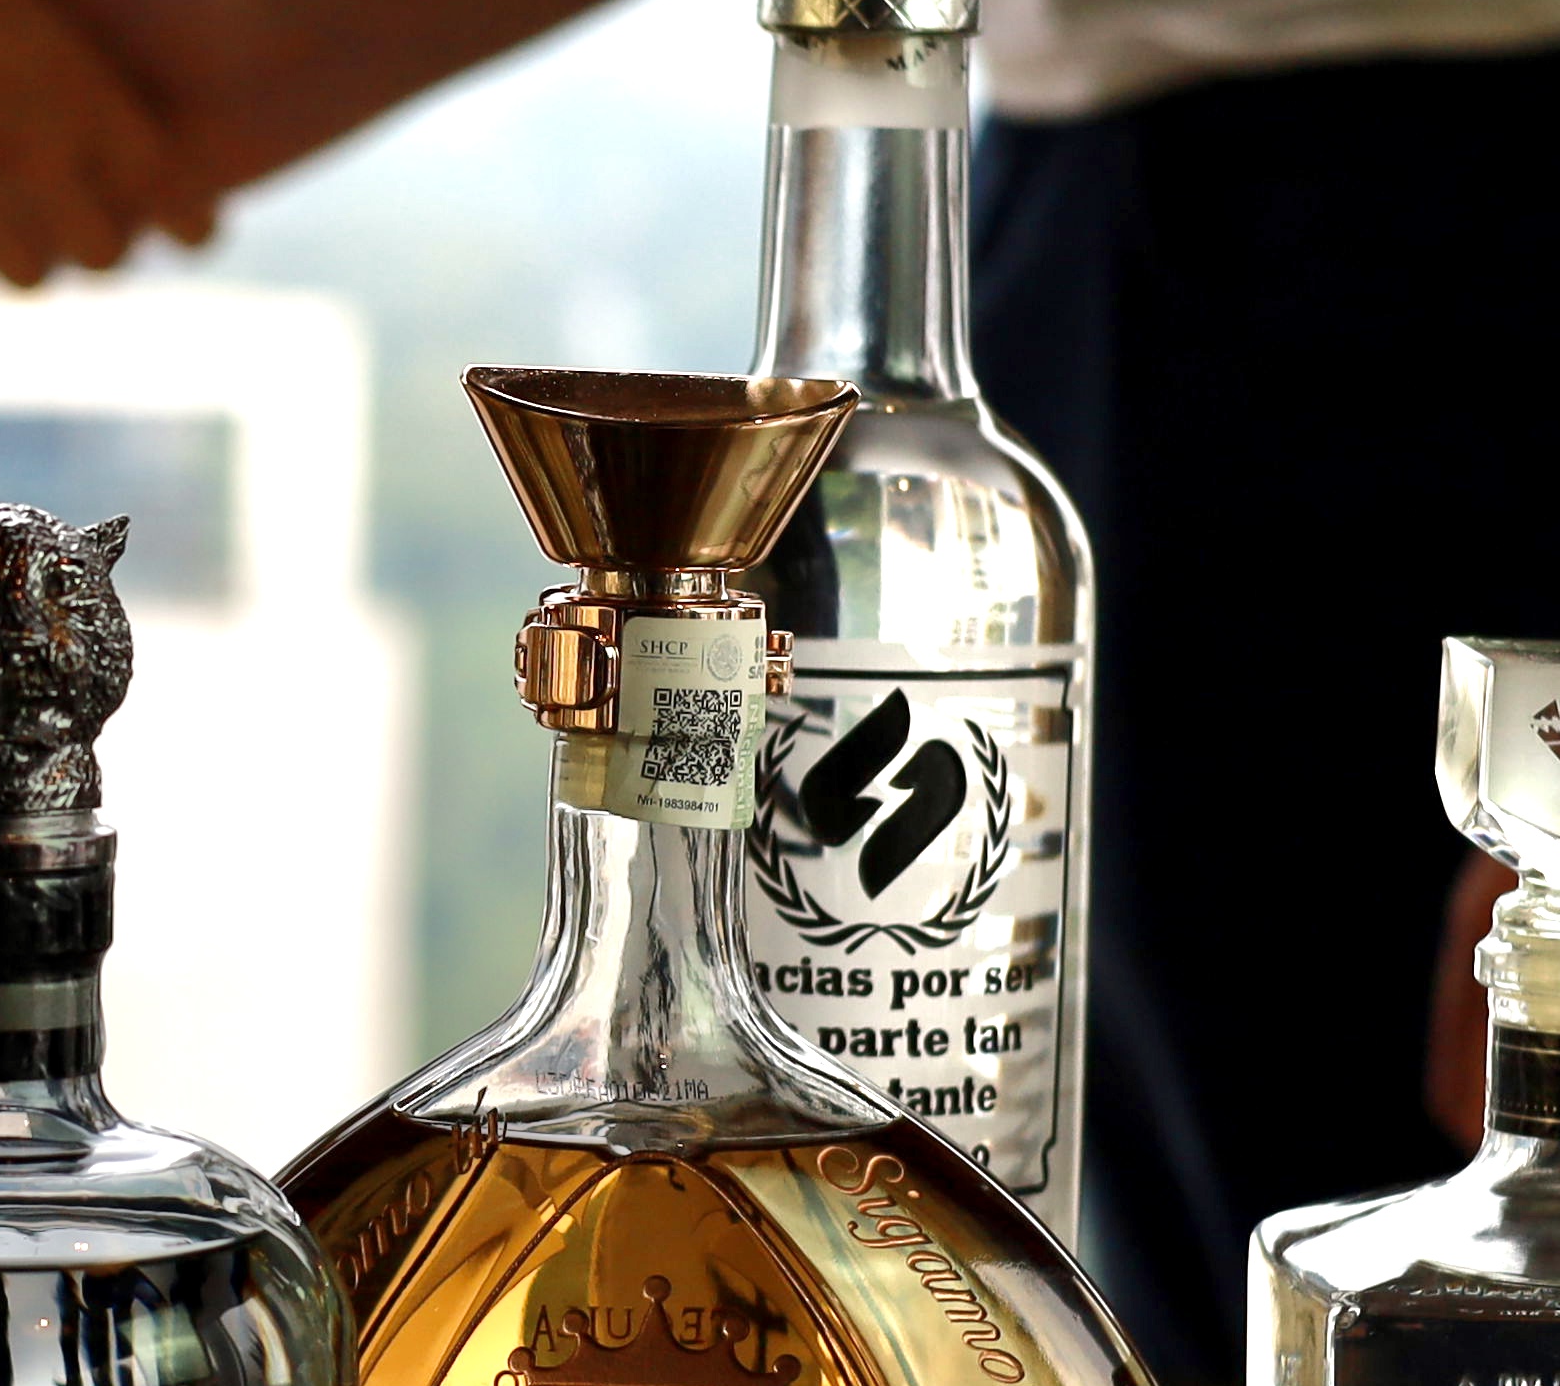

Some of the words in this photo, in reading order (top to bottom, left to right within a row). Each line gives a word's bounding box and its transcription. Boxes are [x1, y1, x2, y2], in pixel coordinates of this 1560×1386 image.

[639, 639, 689, 655] SHCP
[891, 962, 970, 1010] por
[983, 961, 1040, 997] ser
[818, 1018, 949, 1059] parte
[963, 1015, 1023, 1055] tan
